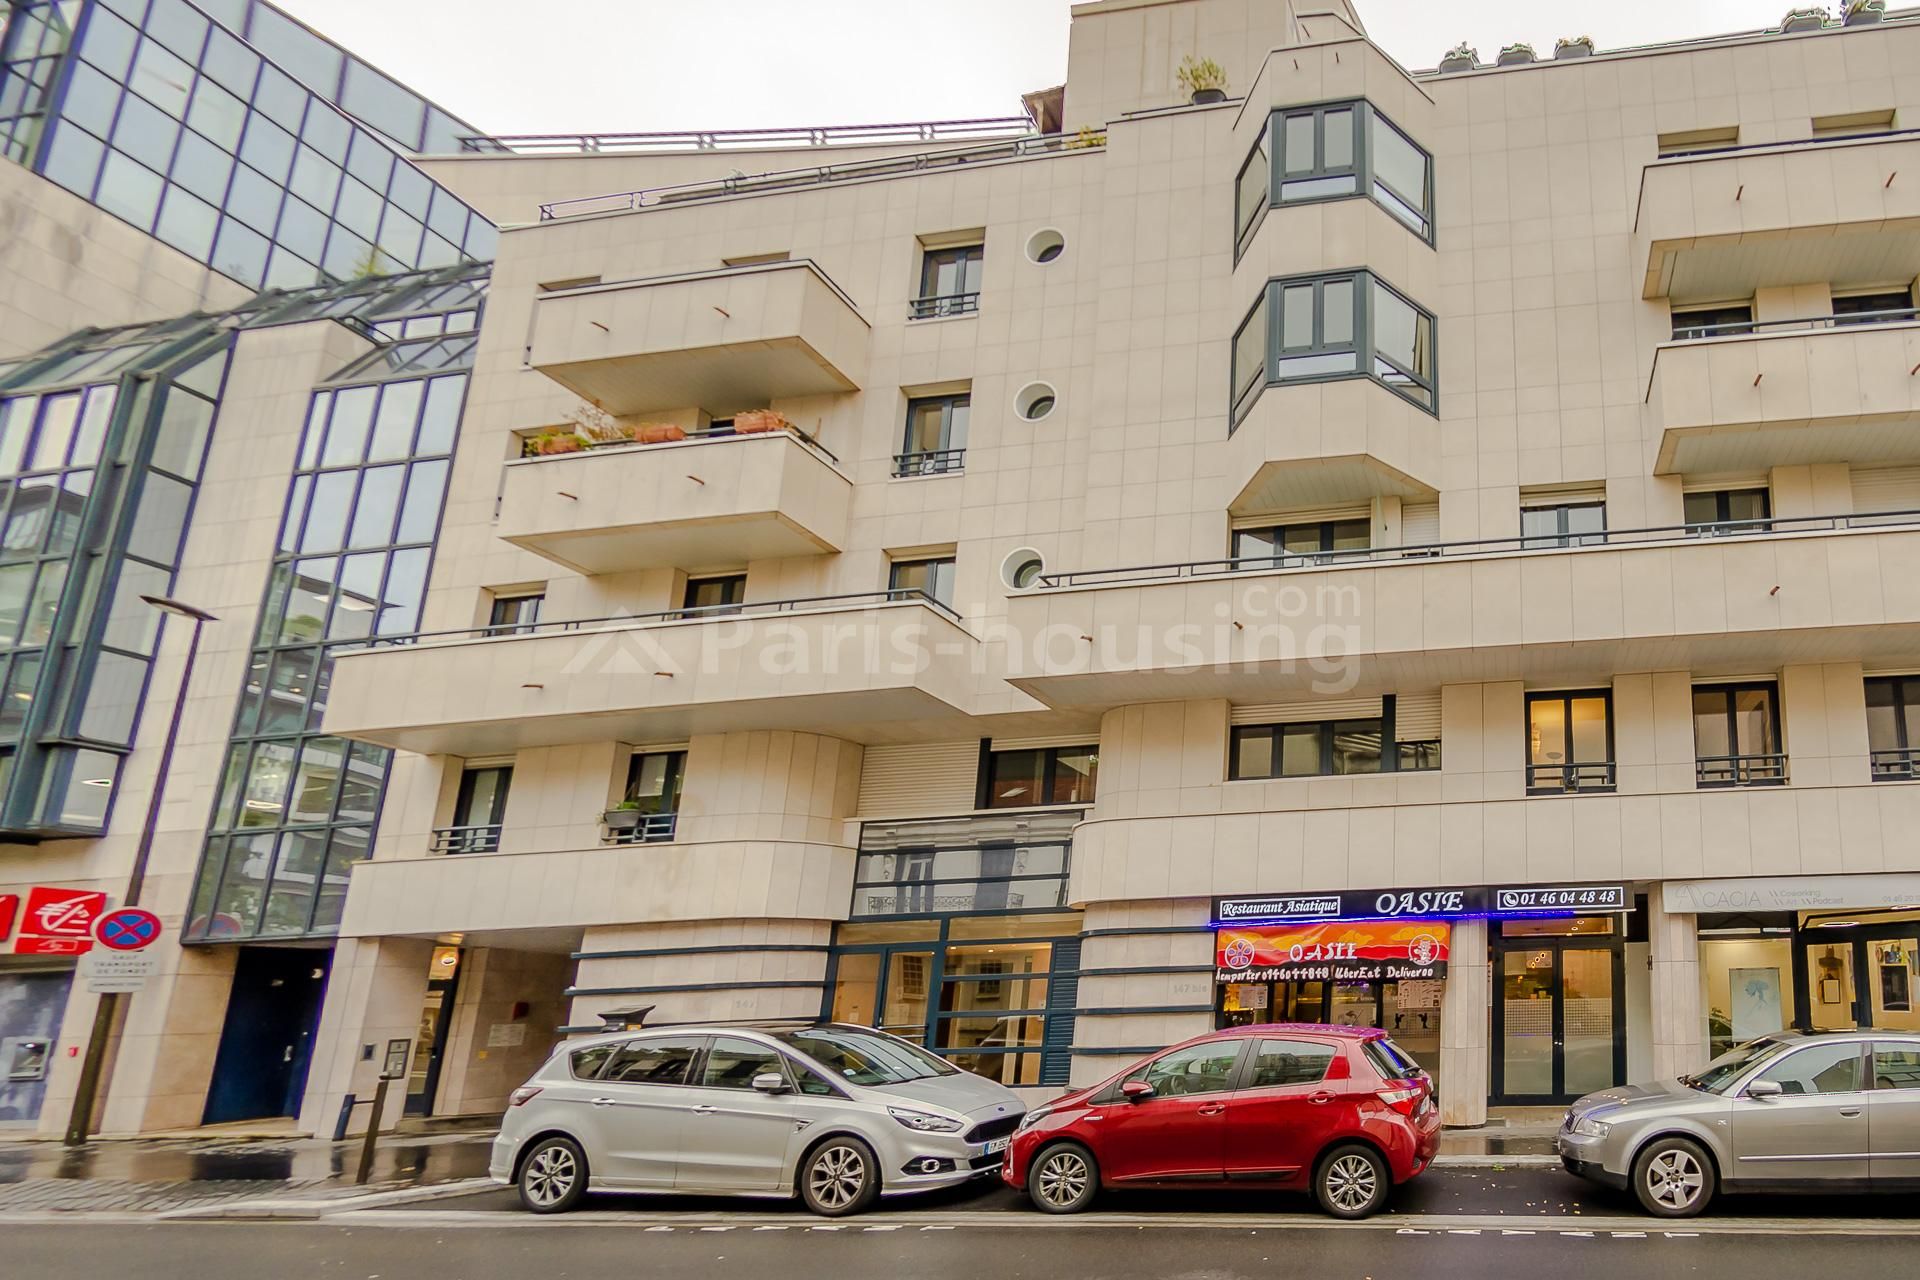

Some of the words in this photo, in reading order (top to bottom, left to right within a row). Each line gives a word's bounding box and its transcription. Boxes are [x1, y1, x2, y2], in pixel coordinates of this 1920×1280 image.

[1375, 890, 1464, 916] OASIE
[1520, 892, 1536, 905] 01
[1540, 891, 1557, 904] 46
[1559, 891, 1576, 903] 04
[1579, 890, 1596, 903] 48
[1599, 890, 1616, 903] 48
[1222, 902, 1283, 916] Restaurant
[1283, 899, 1338, 914] Asiatique
[1335, 966, 1380, 979] UberEat
[1386, 966, 1433, 978] Deliveroo
